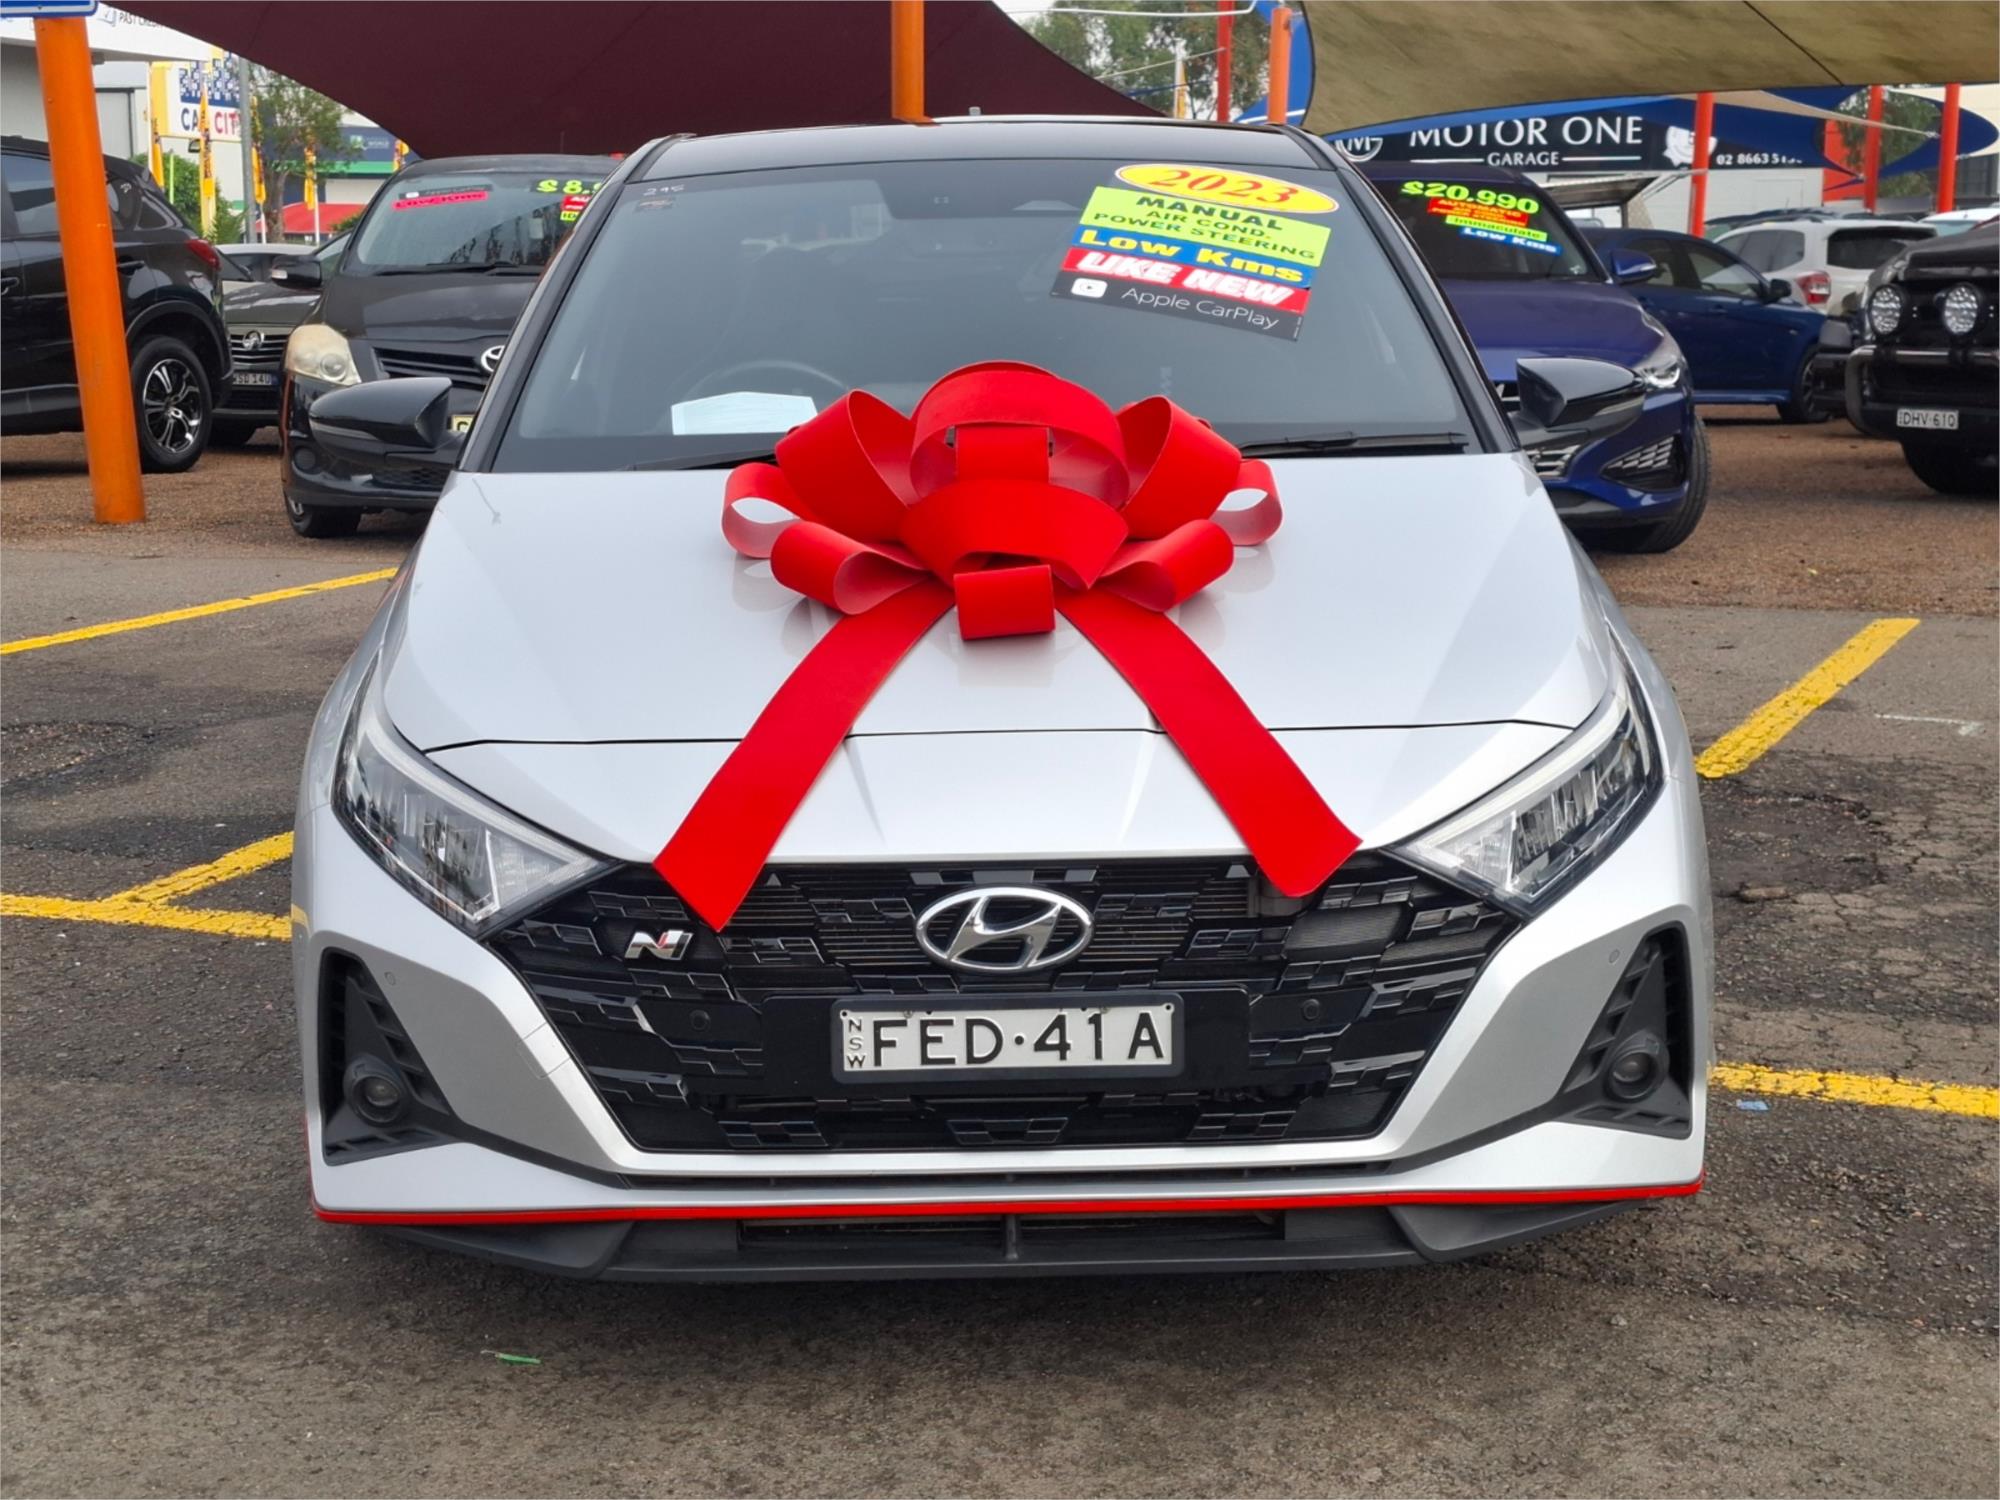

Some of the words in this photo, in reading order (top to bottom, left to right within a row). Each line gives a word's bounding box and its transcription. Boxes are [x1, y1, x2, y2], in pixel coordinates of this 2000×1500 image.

[180, 107, 199, 132] CA
[213, 111, 242, 135] CIT
[1409, 117, 1549, 147] MOTOR
[1561, 116, 1643, 145] ONE
[1487, 152, 1560, 166] GARAGE
[1716, 153, 1734, 166] 02
[1736, 152, 1769, 166] 8663
[1149, 169, 1300, 204] 2023
[1136, 196, 1284, 231] MANUAL
[1146, 209, 1188, 224] AIR
[1093, 212, 1181, 233] POWER
[1191, 226, 1317, 260] STEERING
[1077, 251, 1183, 285] LIKE
[1182, 268, 1295, 305] NEW
[1119, 286, 1189, 310] Apple
[1196, 300, 1280, 331] CarPlay
